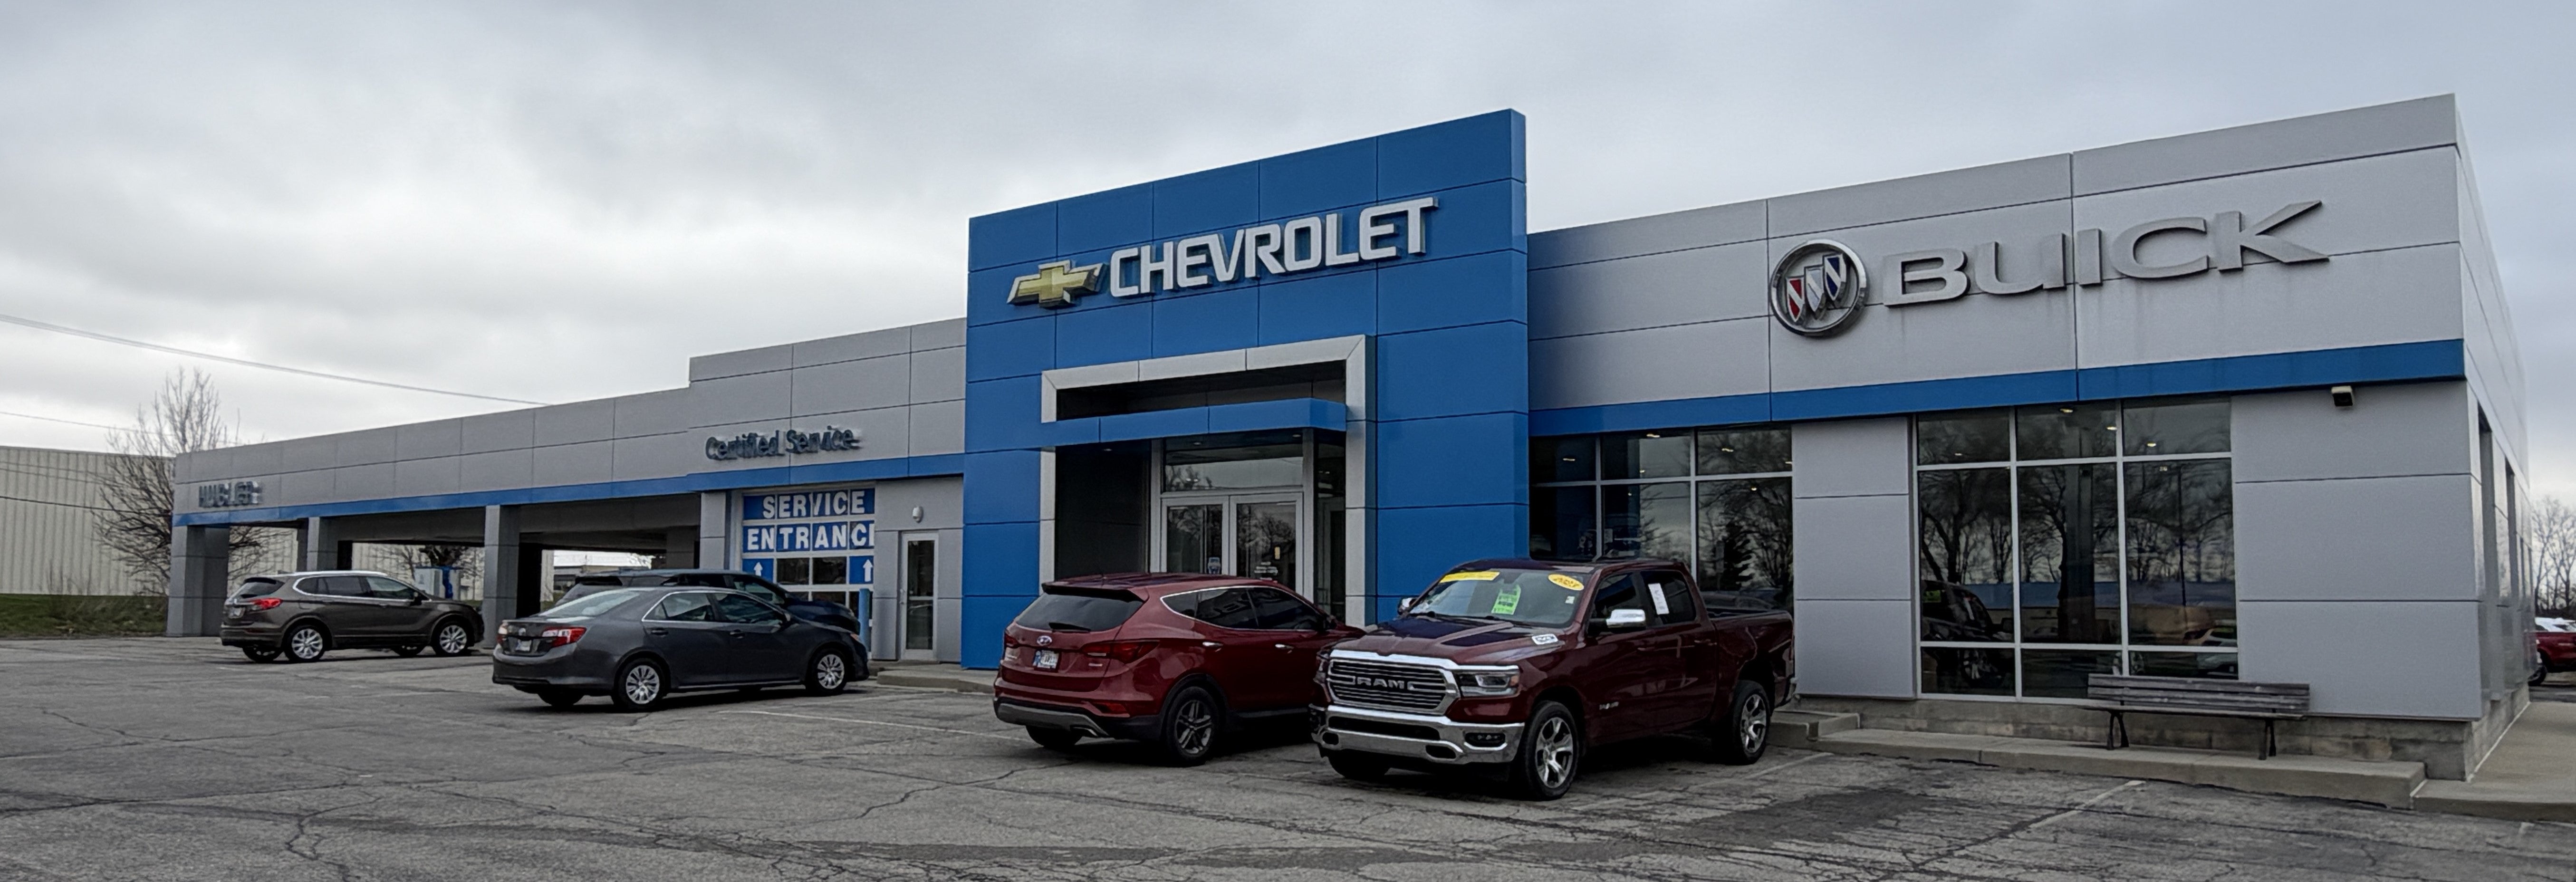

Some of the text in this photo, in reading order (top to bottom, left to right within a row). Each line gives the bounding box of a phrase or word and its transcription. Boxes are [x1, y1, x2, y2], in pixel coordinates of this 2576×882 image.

[1110, 196, 1439, 298] CHEVROLET
[1883, 200, 2330, 308] BUICK
[706, 425, 862, 460] Certified Service
[762, 491, 865, 518] SERVICE
[1356, 676, 1405, 690] RAM
